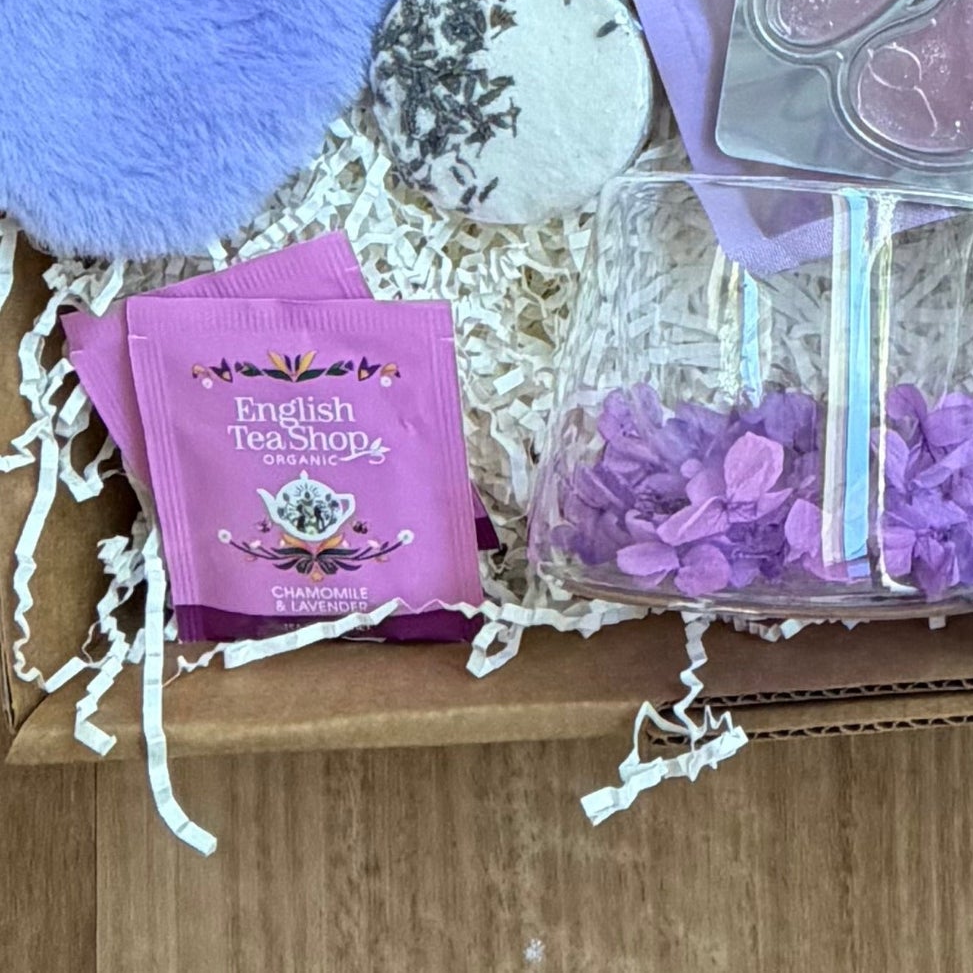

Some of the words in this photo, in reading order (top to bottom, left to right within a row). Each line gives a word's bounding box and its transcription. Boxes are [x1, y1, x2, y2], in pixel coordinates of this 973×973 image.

[234, 396, 356, 429] English
[263, 454, 338, 466] ORGANIC
[271, 586, 369, 600] CHAMOMILE
[275, 600, 286, 612] &
[291, 600, 368, 613] LAVENDER
